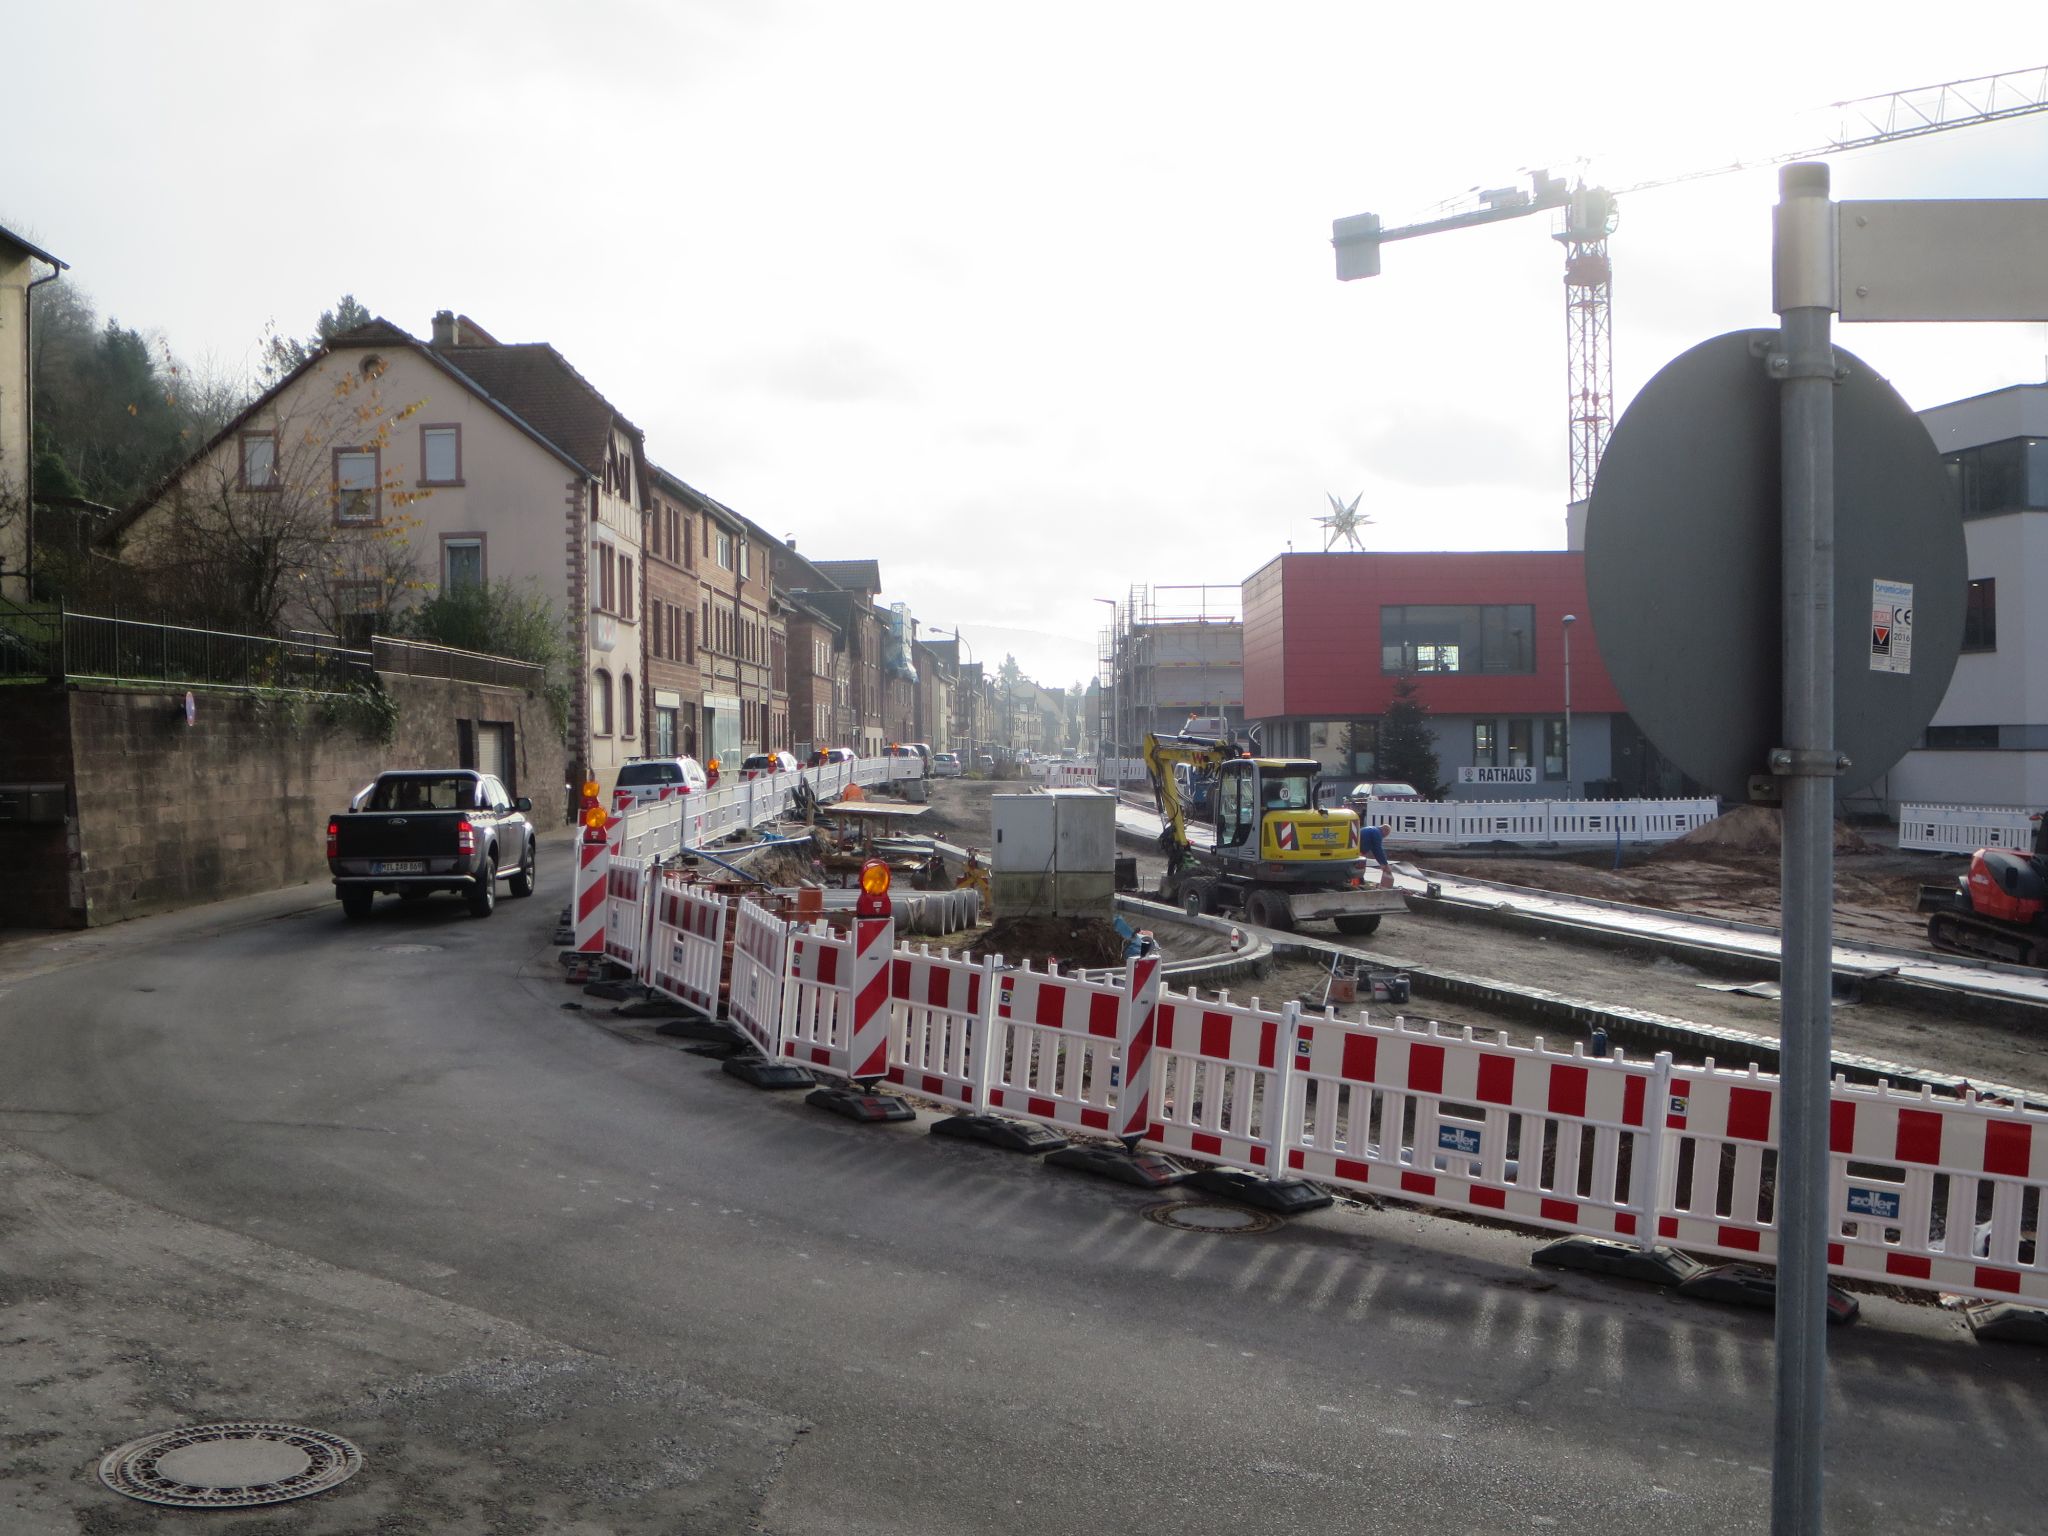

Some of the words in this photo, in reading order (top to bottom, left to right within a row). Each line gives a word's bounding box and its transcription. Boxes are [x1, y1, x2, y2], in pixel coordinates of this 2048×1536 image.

[1894, 608, 1912, 625] CE
[1893, 632, 1911, 642] 2016
[1478, 768, 1532, 782] RATHAUS
[1281, 788, 1289, 798] 20
[1441, 1129, 1478, 1146] zoller
[1851, 1191, 1897, 1210] zoller
